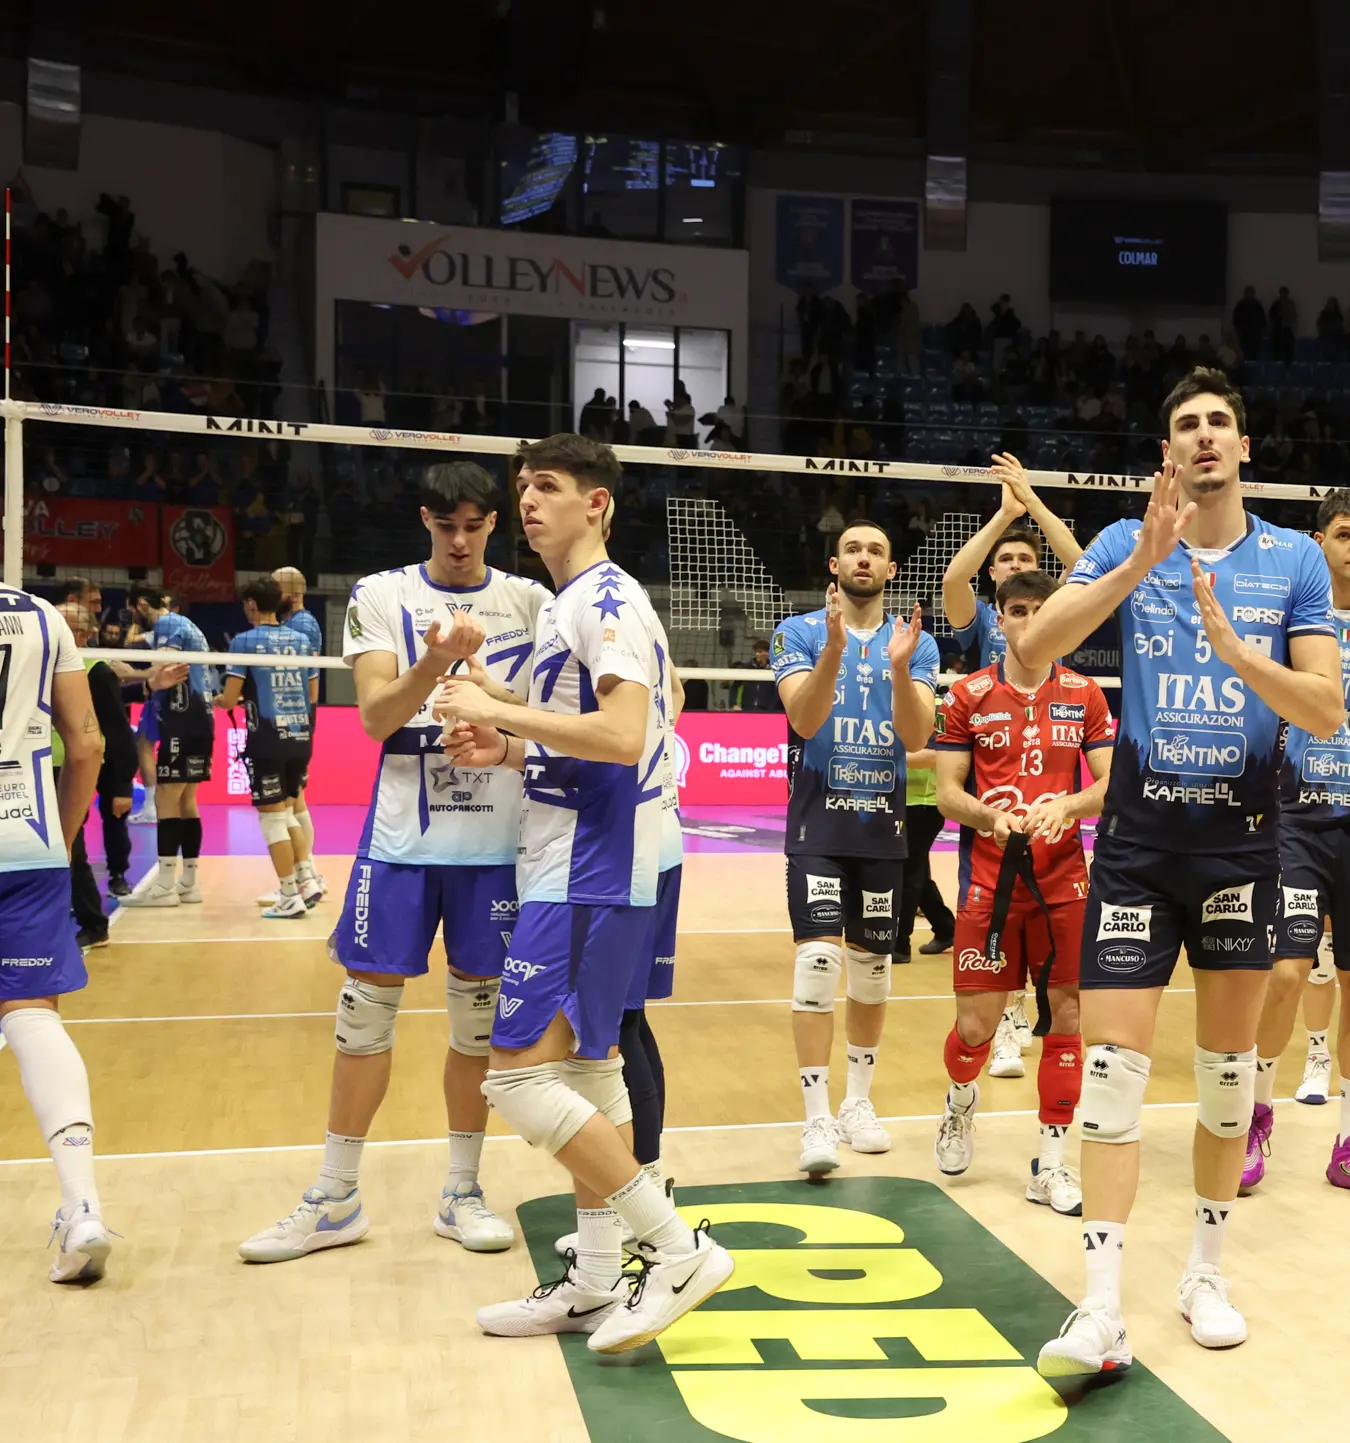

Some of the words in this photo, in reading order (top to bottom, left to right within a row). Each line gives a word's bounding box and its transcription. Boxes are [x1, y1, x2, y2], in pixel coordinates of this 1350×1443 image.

[1118, 251, 1158, 266] COLMAR
[66, 406, 142, 419] VEROVOLLEY
[206, 416, 309, 436] MINT
[394, 432, 462, 442] VEROVOLLEY
[691, 450, 752, 461] VEROVOLLEY
[805, 458, 890, 474] MINT
[1067, 473, 1146, 488] MINT
[1232, 606, 1285, 626] FORST
[485, 627, 529, 647] FREDDY
[1133, 630, 1174, 658] Gpi
[1195, 631, 1212, 664] 5
[270, 672, 303, 687] ITAS
[860, 686, 870, 711] 7
[1157, 673, 1246, 714] ITAS
[1155, 712, 1244, 728] ASSICURAZIONI
[832, 716, 895, 747] ITAS
[832, 744, 895, 757] ASSICURAZIONI
[1154, 736, 1240, 767] TRENTINO
[1018, 748, 1044, 777] 13
[158, 766, 170, 778] 23
[462, 772, 494, 784] TXT
[720, 769, 767, 779] AGAINST
[769, 769, 788, 779] ABU
[832, 764, 892, 786] TRENTINO
[1142, 782, 1242, 807] KARRELL
[0, 804, 34, 821] uad
[429, 804, 494, 813] AUTOPANCOTTI
[825, 796, 894, 814] KARRELL
[816, 880, 835, 889] SAN
[871, 897, 889, 905] SAN
[1212, 892, 1241, 904] SAN
[1293, 893, 1313, 903] SAN
[354, 864, 372, 949] FREDDY
[1205, 902, 1248, 915] CARLO
[1287, 901, 1317, 911] CARLO
[1111, 912, 1140, 923] SAN
[1102, 921, 1147, 934] CARLO
[1, 957, 53, 967] FREDDY
[655, 956, 676, 965] FRE
[1105, 954, 1141, 964] MANCUSO
